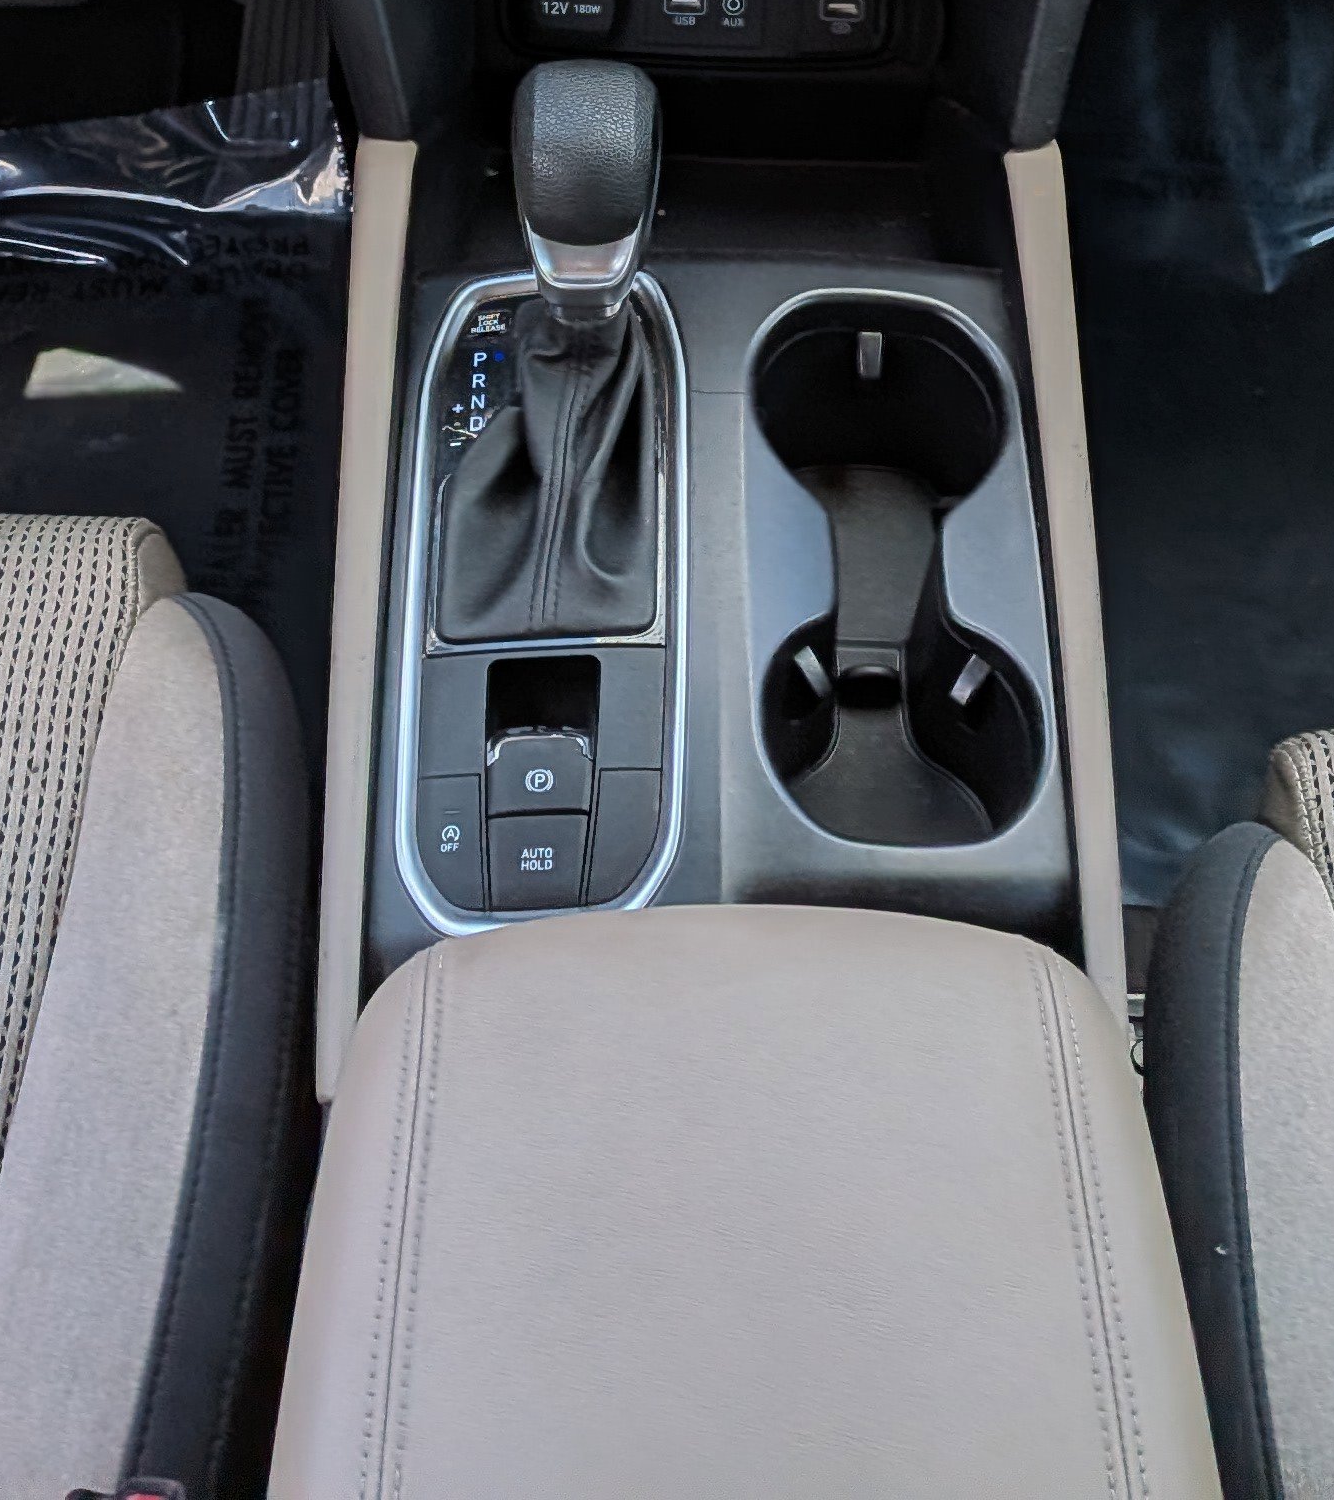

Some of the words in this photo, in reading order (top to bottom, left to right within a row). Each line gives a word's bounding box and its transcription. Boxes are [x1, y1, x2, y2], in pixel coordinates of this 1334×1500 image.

[542, 1, 570, 15] 12V
[674, 16, 696, 27] USB
[722, 17, 744, 28] AUX
[470, 324, 506, 333] RELEASE
[473, 352, 487, 367] P
[472, 374, 486, 388] R
[470, 394, 485, 410] N
[469, 416, 484, 432] D
[440, 843, 460, 853] OFF
[520, 848, 554, 859] AUTO
[520, 860, 554, 871] HOLD
